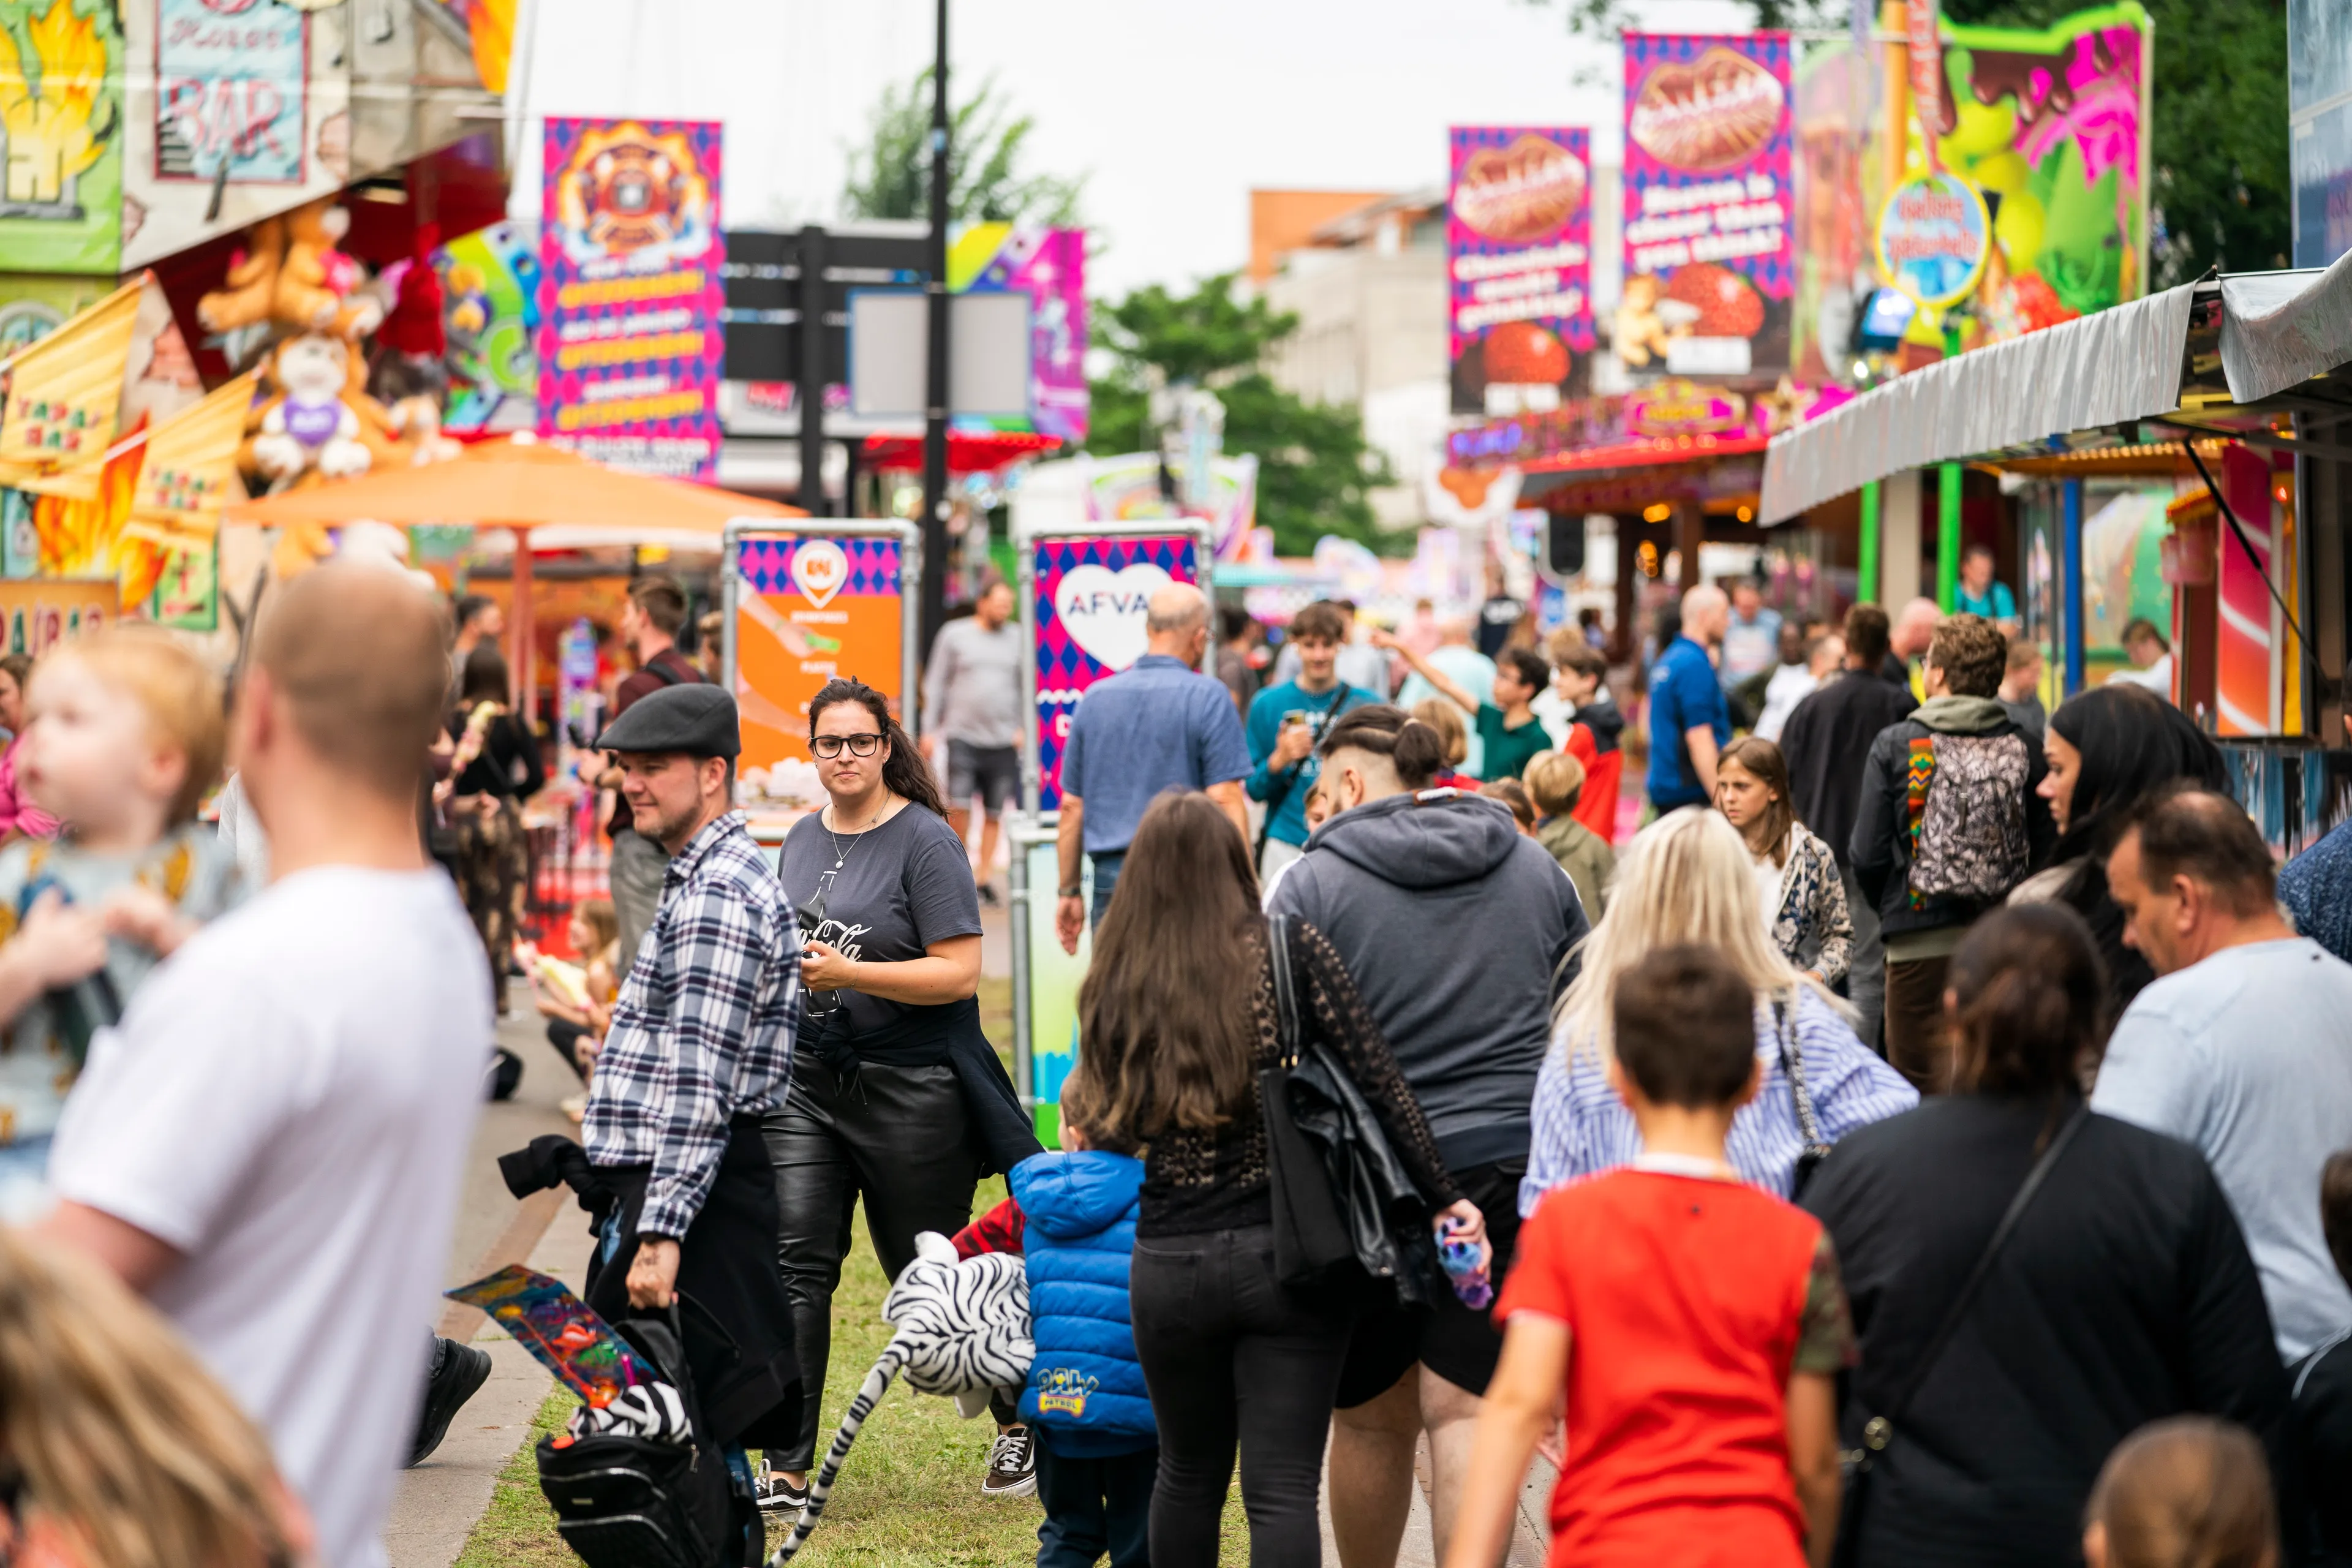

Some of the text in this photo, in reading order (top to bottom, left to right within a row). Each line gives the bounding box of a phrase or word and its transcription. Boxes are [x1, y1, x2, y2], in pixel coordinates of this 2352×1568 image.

[169, 78, 285, 157] BAR
[17, 396, 103, 430] TAPAS
[1068, 591, 1149, 615] AFVA
[1037, 1368, 1099, 1398] PAW
[1045, 1398, 1077, 1408] PATROL
